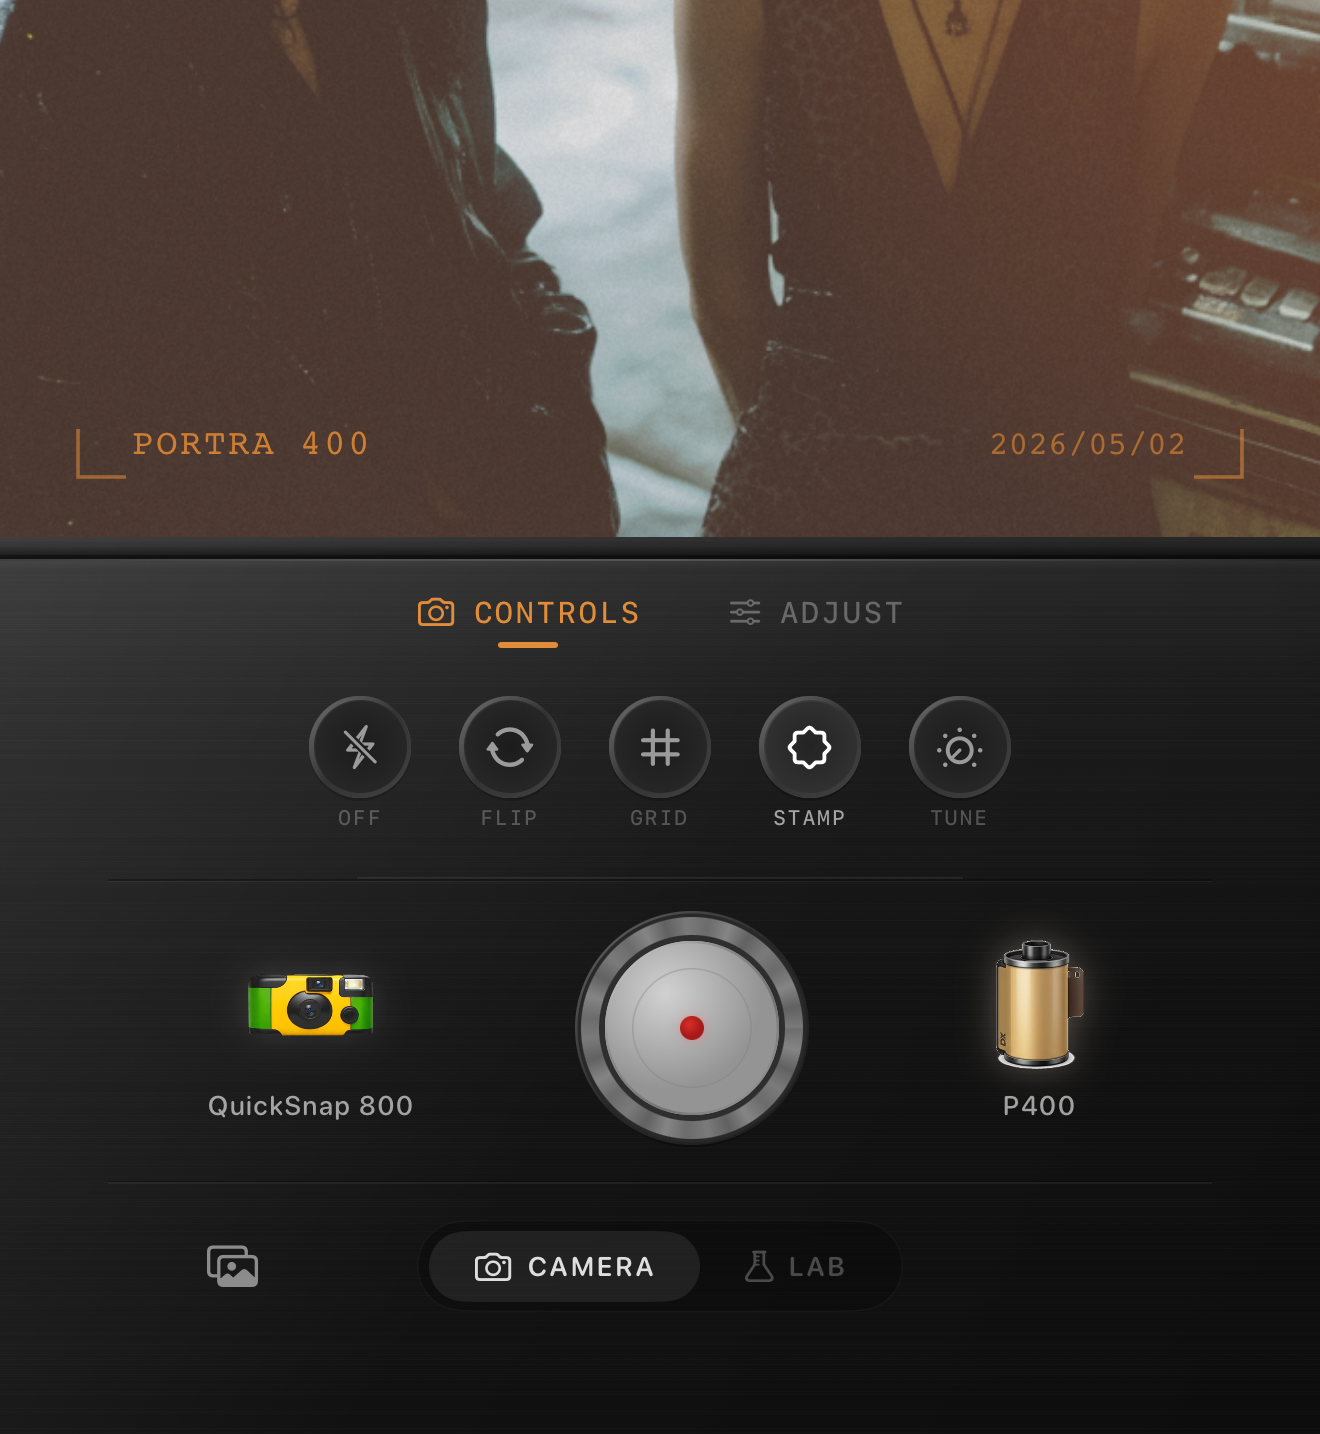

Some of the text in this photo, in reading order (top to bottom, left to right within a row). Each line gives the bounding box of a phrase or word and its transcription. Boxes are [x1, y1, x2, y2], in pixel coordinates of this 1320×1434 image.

[474, 600, 639, 625] CONTROLS
[780, 600, 903, 625] ADJUST
[338, 809, 380, 826] OFF
[481, 809, 537, 826] FLIP
[630, 809, 687, 826] GRID
[773, 809, 845, 826] STAMP
[930, 809, 986, 826] TUNE
[999, 1031, 1007, 1047] DX
[208, 1094, 413, 1121] QuickSnap 800
[1003, 1095, 1075, 1116] P400
[527, 1256, 655, 1277] CAMERA
[789, 1256, 846, 1277] LAB
